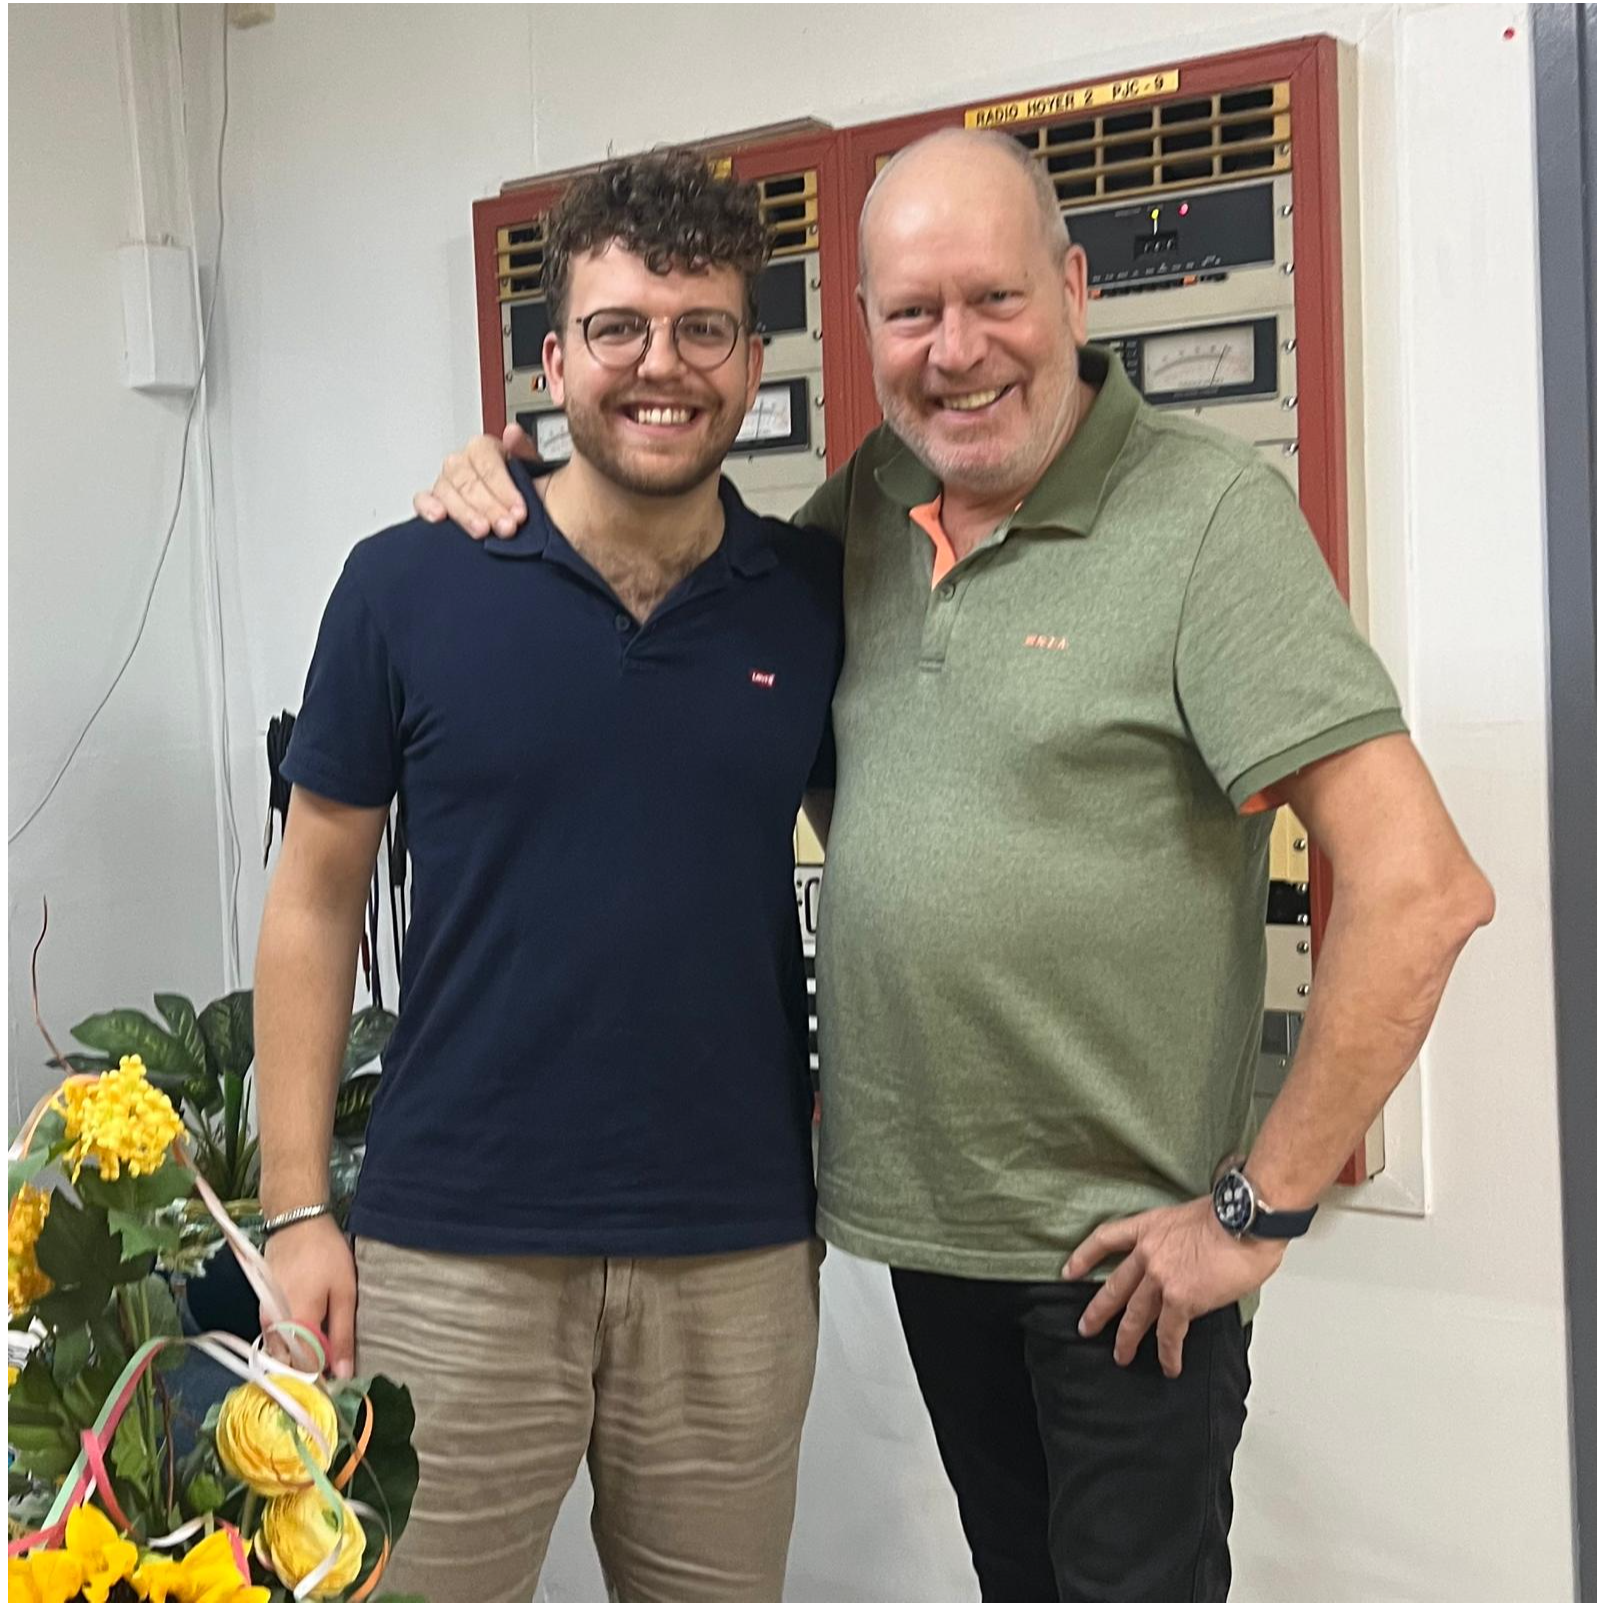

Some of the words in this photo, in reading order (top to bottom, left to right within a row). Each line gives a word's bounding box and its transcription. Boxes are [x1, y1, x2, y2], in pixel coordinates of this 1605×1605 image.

[976, 106, 1019, 127] RADIO
[1027, 93, 1075, 117] HOYER
[1084, 89, 1094, 105] 2
